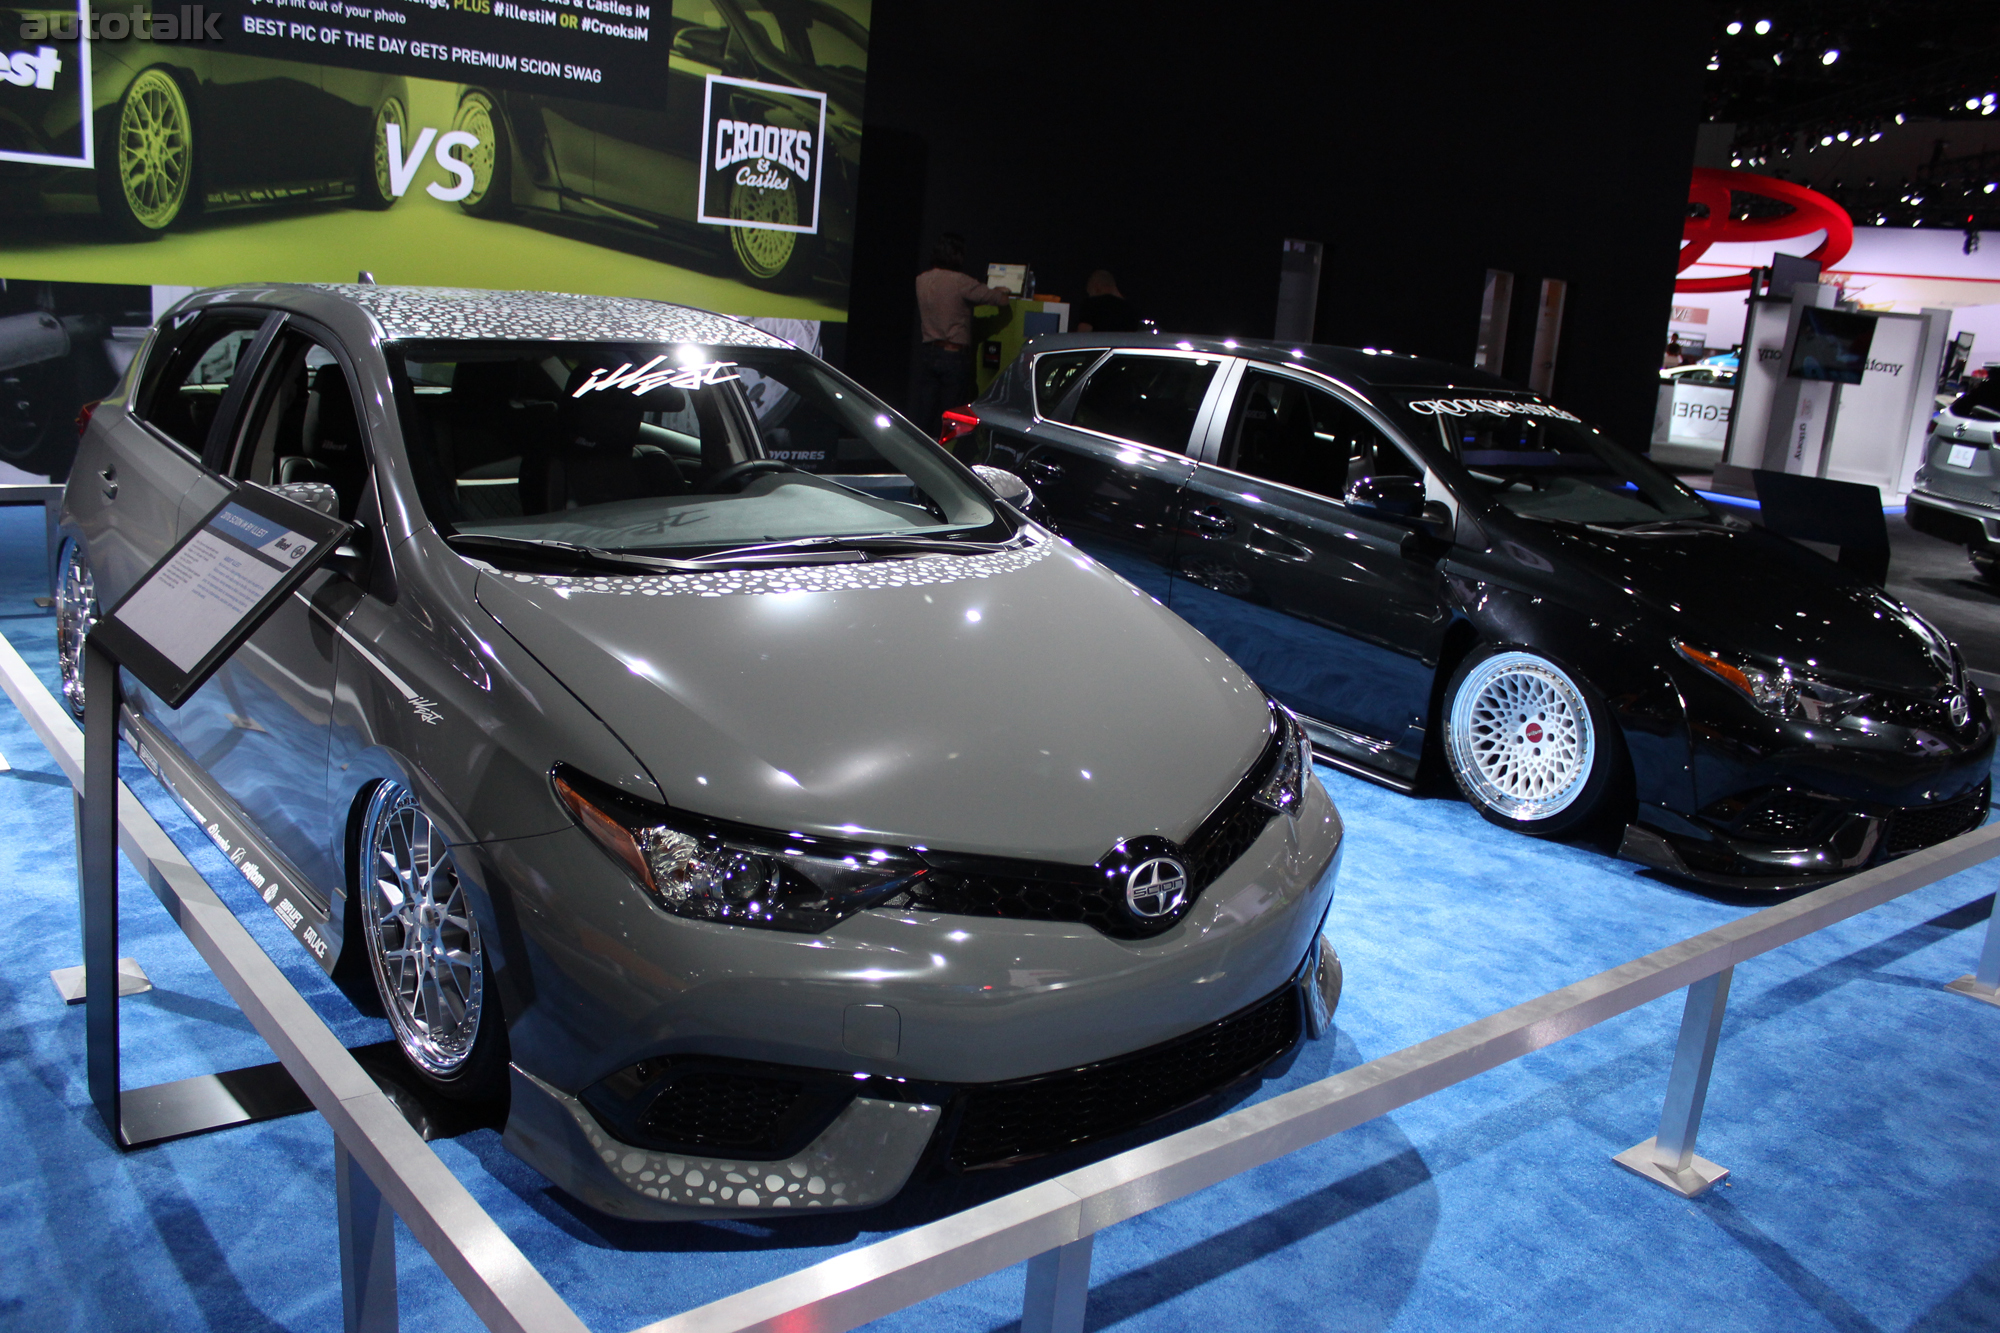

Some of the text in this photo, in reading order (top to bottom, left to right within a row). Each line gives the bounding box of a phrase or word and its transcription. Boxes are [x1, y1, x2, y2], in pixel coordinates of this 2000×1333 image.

[308, 0, 328, 12] out
[330, 1, 343, 14] of
[344, 5, 371, 18] your
[374, 8, 406, 24] photo
[453, 0, 491, 15] PLUS
[494, 1, 557, 26] #illestiM
[560, 13, 579, 30] OR
[581, 16, 649, 42] #CrooksiM
[586, 0, 633, 17] Castles
[635, 4, 650, 20] iM
[243, 15, 602, 84] BEST PIC OF THE DAY GETS PREMIUM SCION SWAG
[386, 122, 480, 202] VS
[715, 118, 812, 182] CROOKS
[736, 165, 789, 190] Castles
[757, 158, 770, 173] &
[791, 450, 826, 460] TIRES
